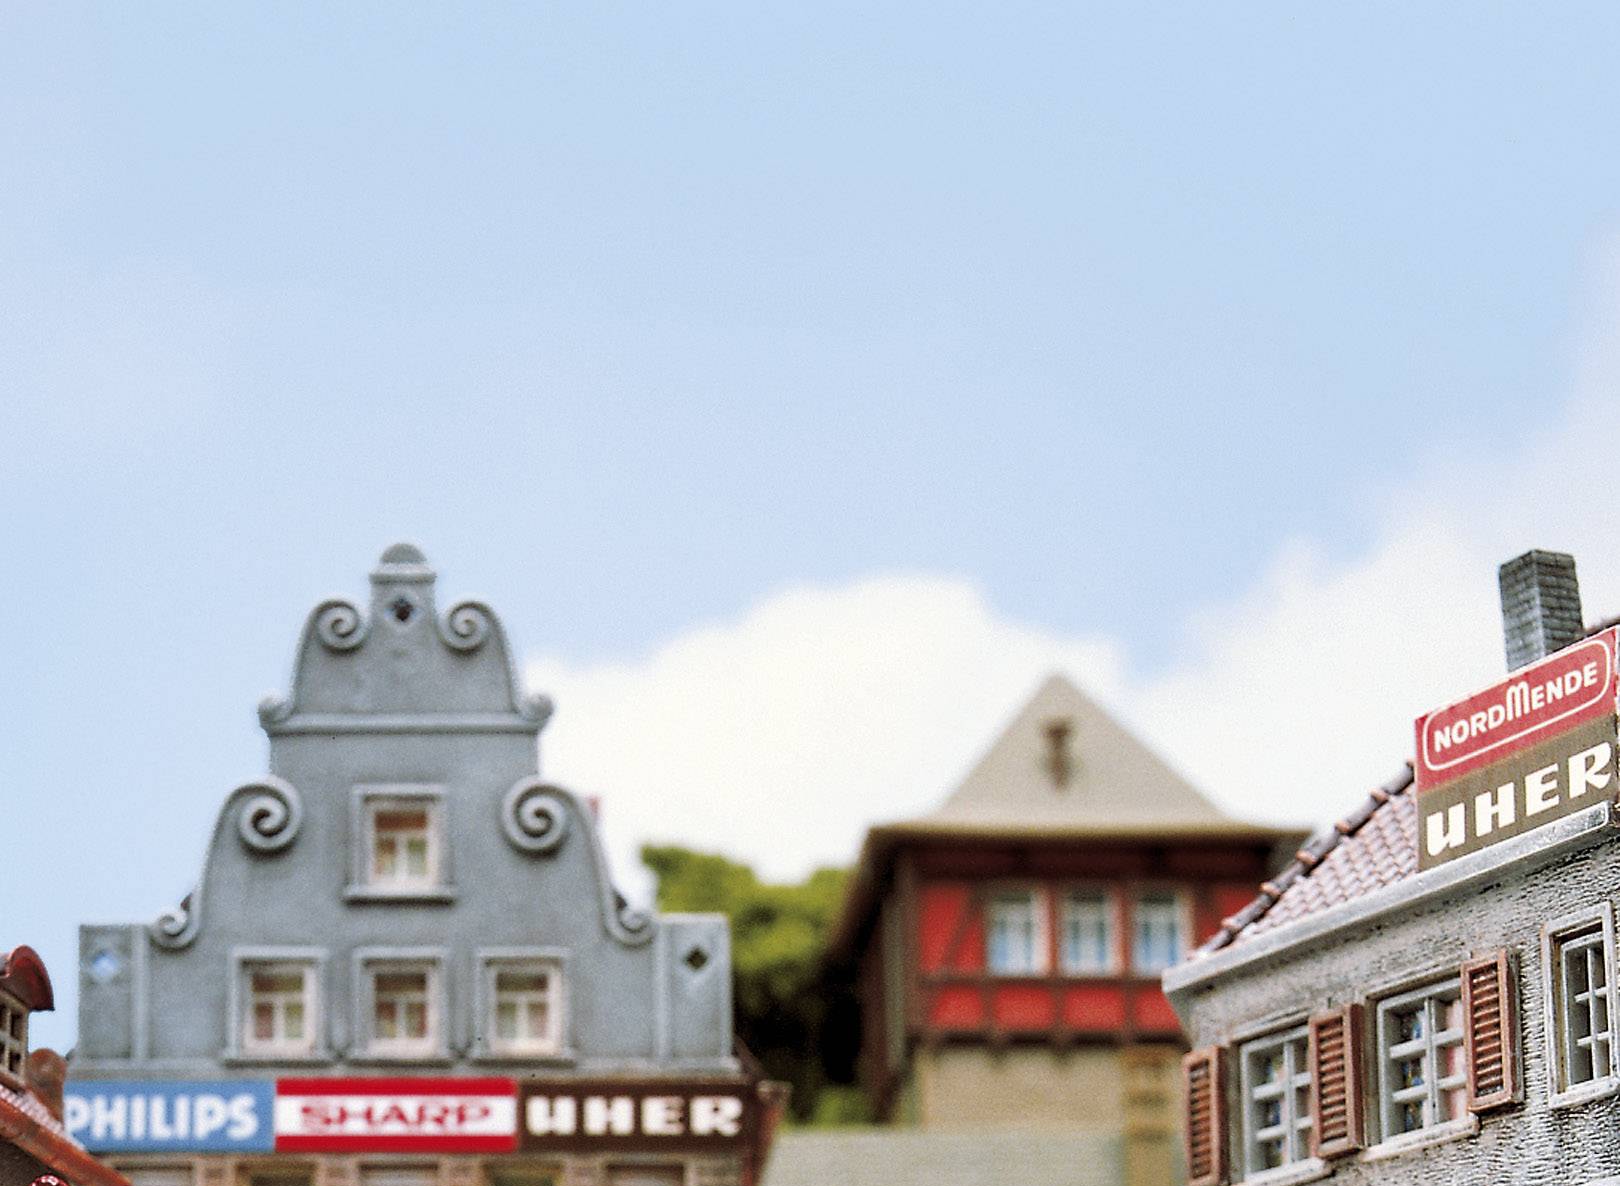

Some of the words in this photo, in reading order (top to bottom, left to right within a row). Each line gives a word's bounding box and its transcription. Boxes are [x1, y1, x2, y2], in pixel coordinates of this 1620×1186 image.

[1433, 662, 1598, 753] NORDMENDE
[1426, 742, 1612, 857] UHER
[64, 1094, 259, 1140] PHILIPS
[300, 1102, 491, 1134] SHARP
[526, 1095, 743, 1136] UHER
